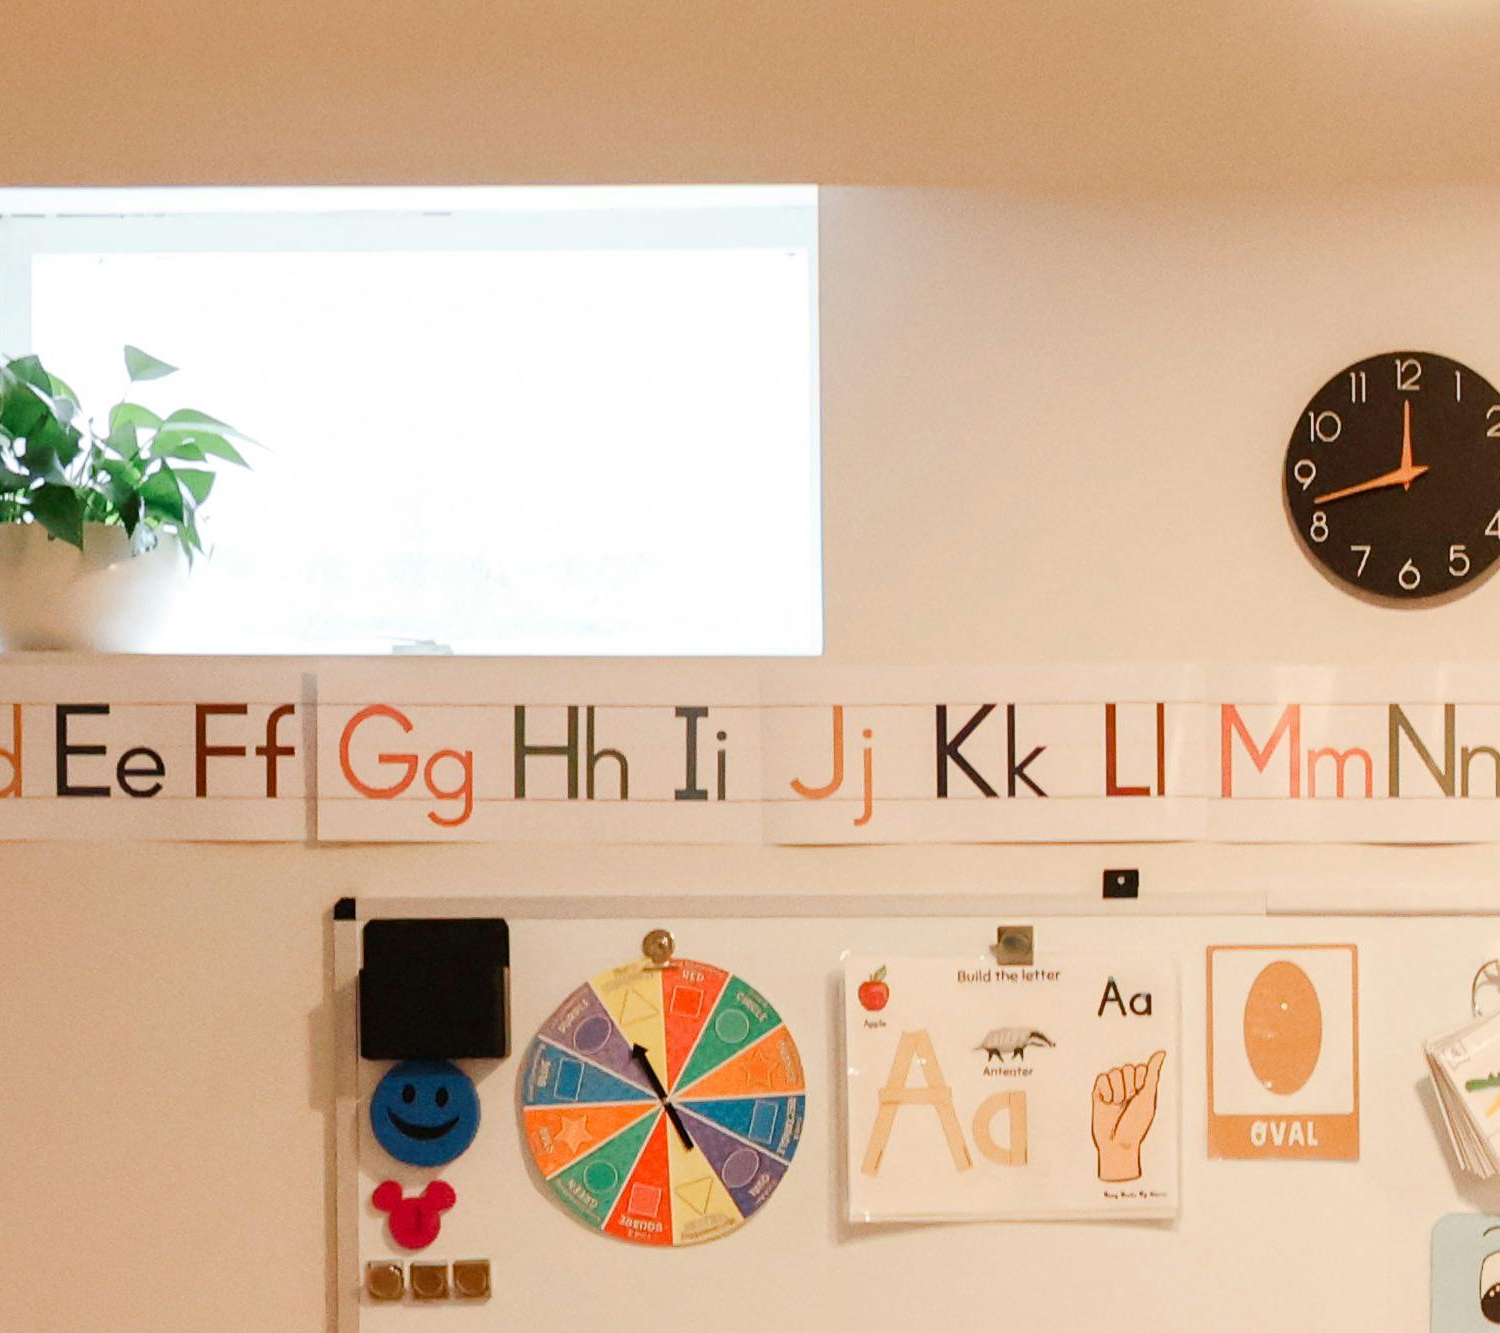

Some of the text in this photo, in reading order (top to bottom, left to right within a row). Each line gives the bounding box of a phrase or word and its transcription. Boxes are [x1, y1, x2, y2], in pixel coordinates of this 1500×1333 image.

[1350, 370, 1367, 403] 11
[1395, 359, 1422, 391] 12
[1454, 370, 1462, 402] 1
[1308, 410, 1342, 442] 10
[1294, 458, 1316, 491] 9
[1309, 511, 1329, 542] 8
[1350, 544, 1371, 577] 7
[1398, 558, 1421, 590] 6
[1448, 544, 1470, 576] 5
[55, 702, 166, 800] Ee
[195, 702, 296, 800] Ff
[339, 704, 474, 828] Gg
[514, 704, 629, 801] Hh
[674, 705, 727, 801] Ii
[790, 704, 874, 826] Jj
[935, 704, 1049, 800] Kk
[1104, 703, 1166, 797] Ll
[1219, 704, 1374, 798] Mm
[957, 968, 1060, 984] Build the letter
[1097, 976, 1152, 1019] Aa
[863, 1018, 888, 1029] Apple
[982, 1065, 1034, 1079] Anteater
[1250, 1120, 1319, 1148] OVAL
